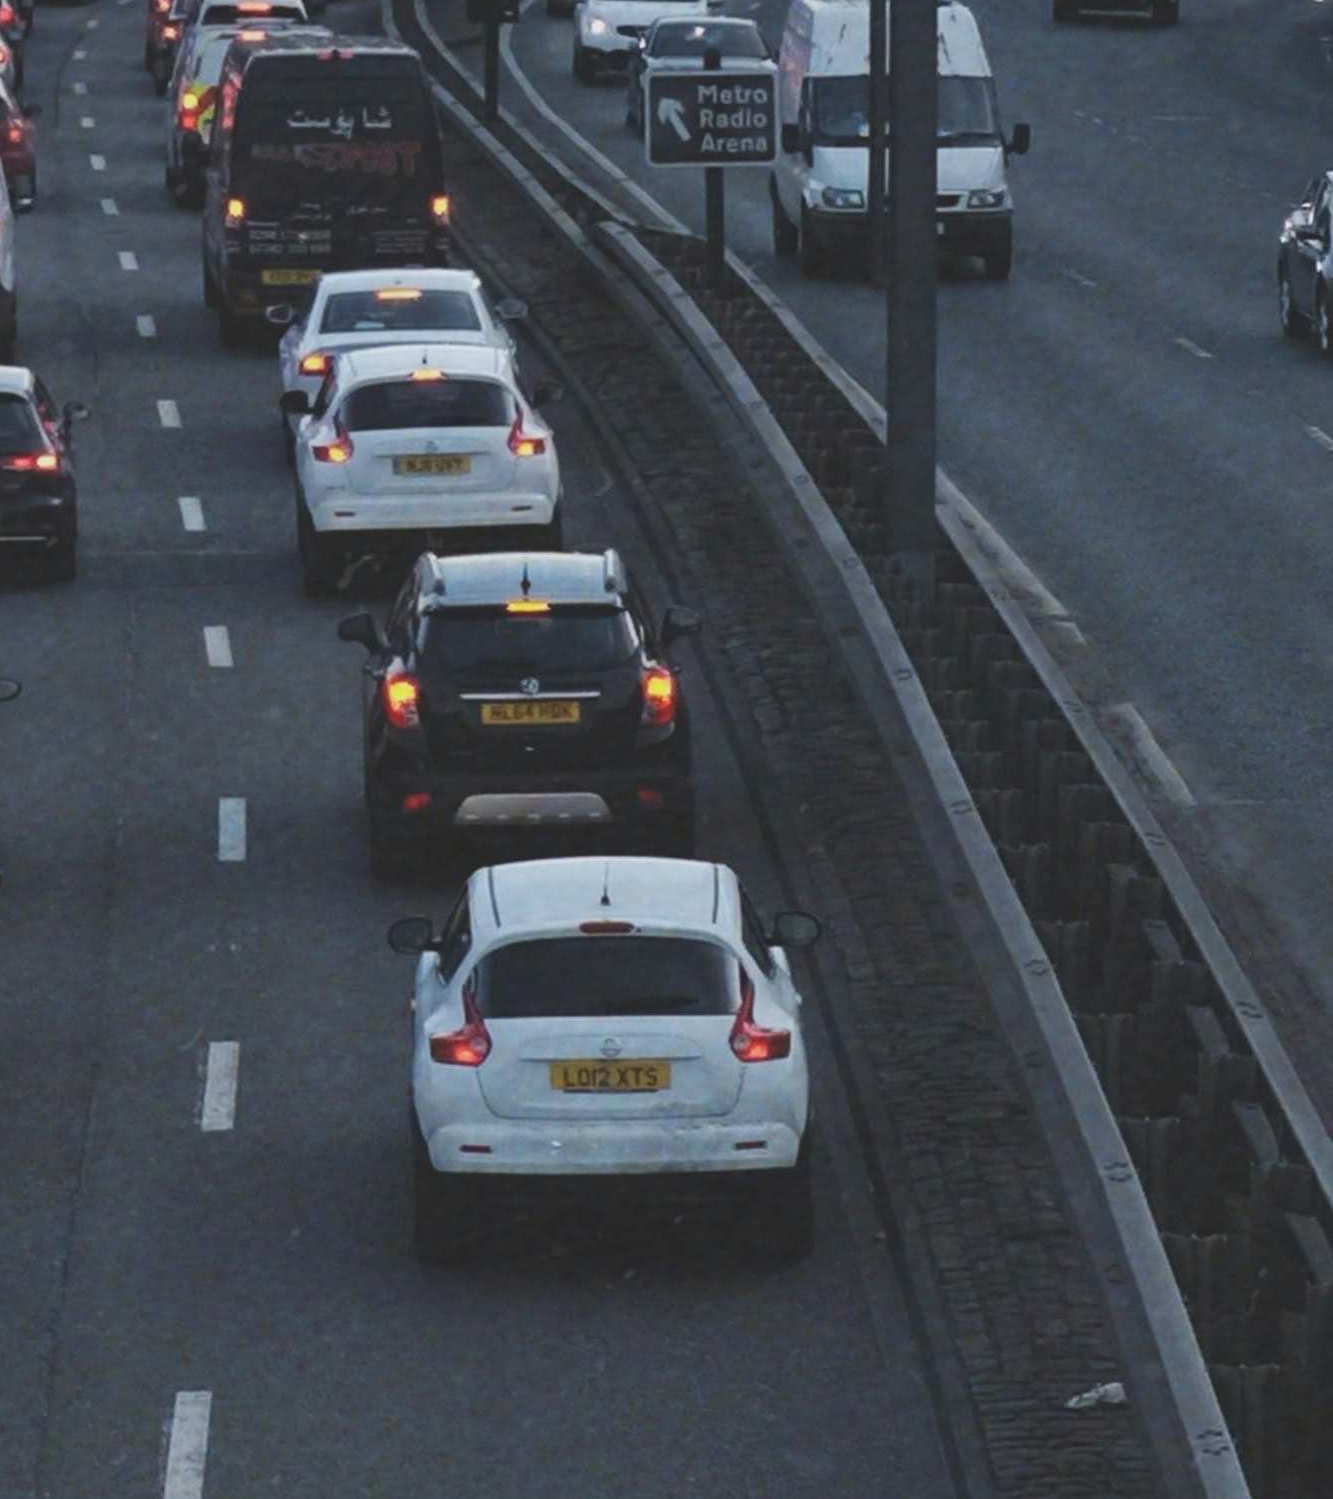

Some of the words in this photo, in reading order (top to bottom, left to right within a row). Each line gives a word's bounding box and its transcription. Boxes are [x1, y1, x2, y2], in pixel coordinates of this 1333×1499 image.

[698, 85, 768, 105] Metro
[699, 108, 768, 128] Radio
[701, 133, 769, 153] Arena
[616, 1066, 660, 1088] XTS
